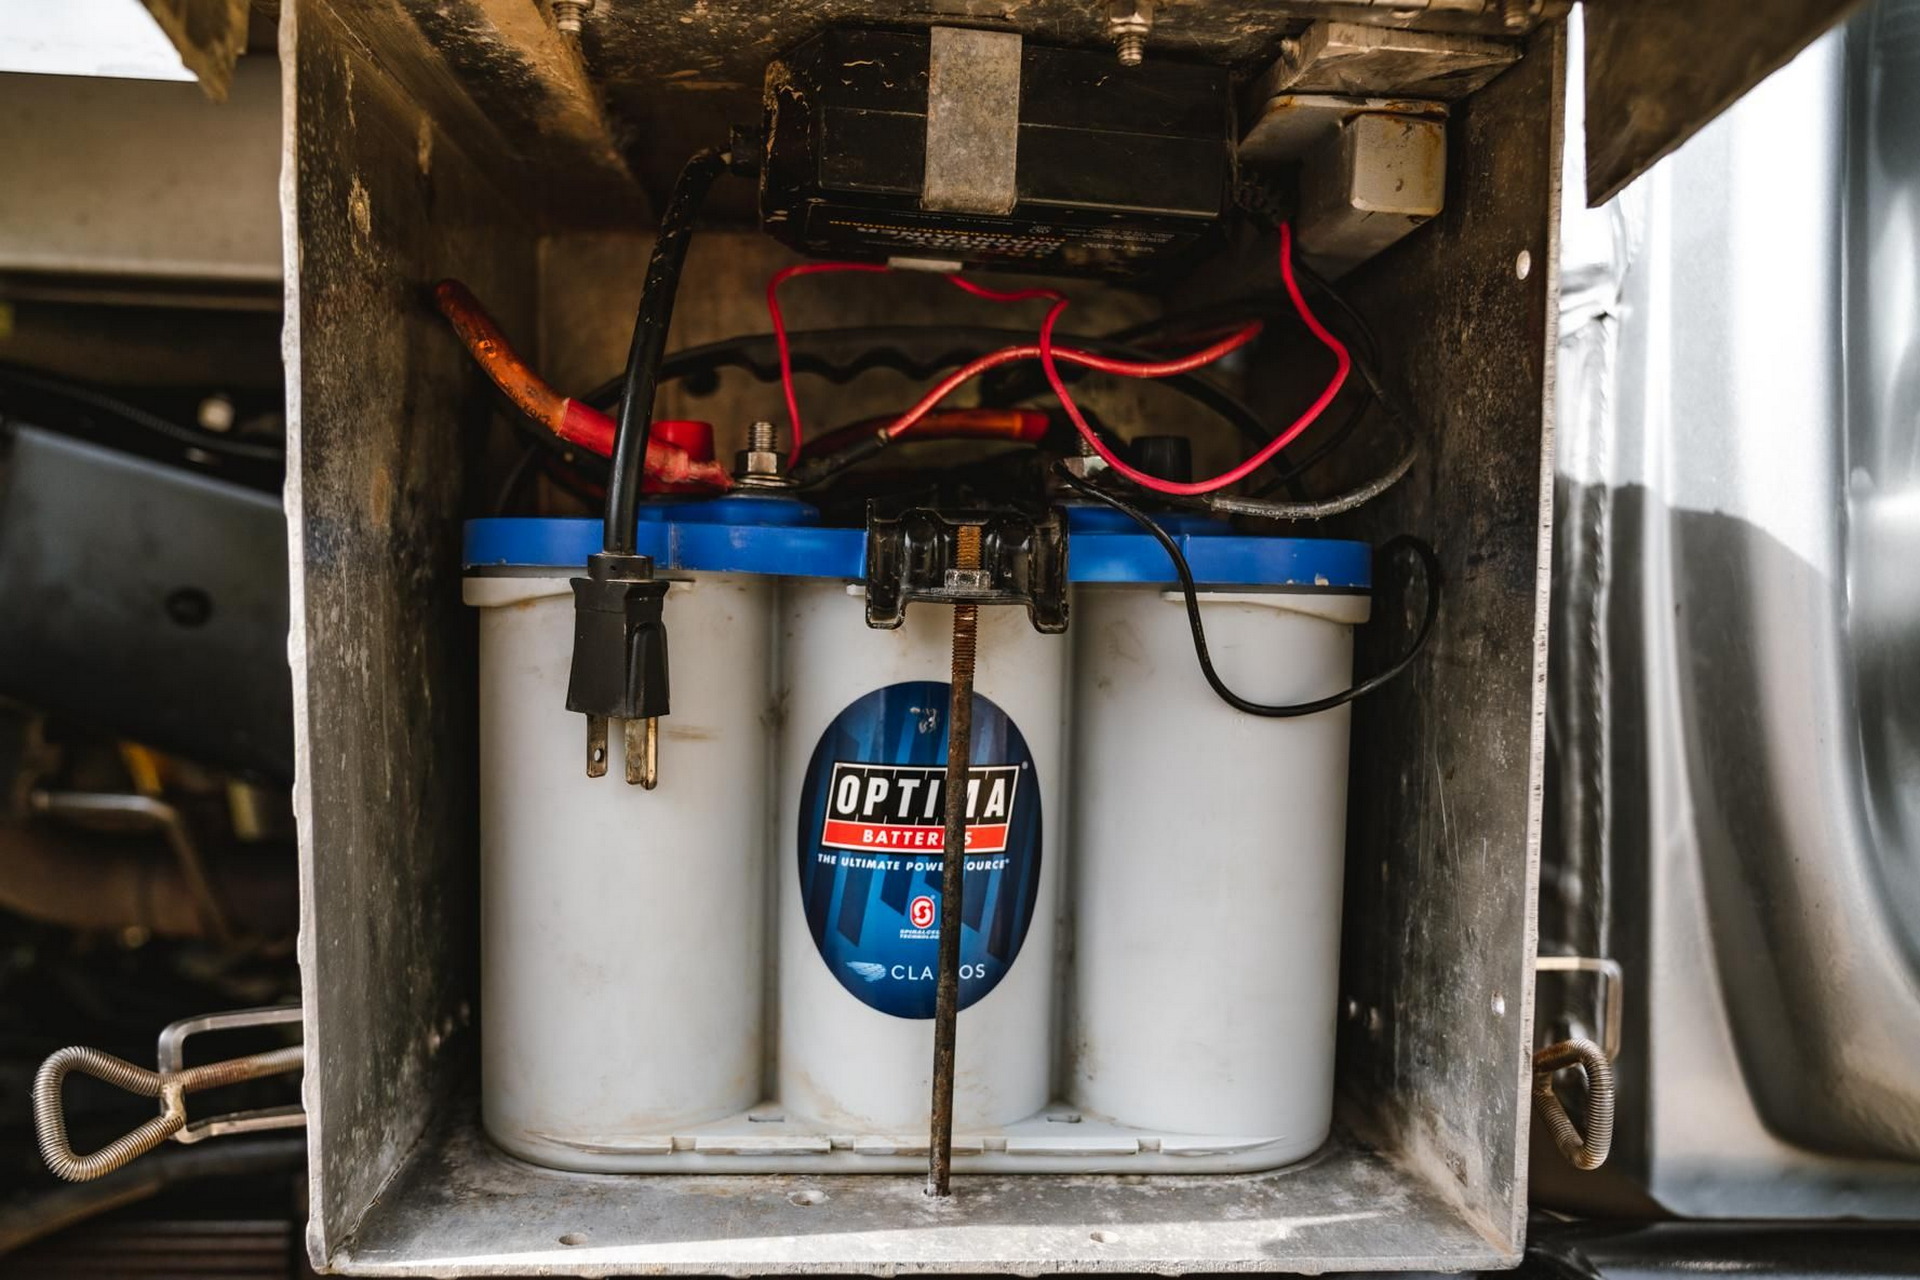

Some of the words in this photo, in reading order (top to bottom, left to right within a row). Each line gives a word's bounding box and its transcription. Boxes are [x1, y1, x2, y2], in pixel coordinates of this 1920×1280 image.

[817, 853, 837, 866] THE
[841, 856, 900, 871] ULTIMATE
[906, 861, 944, 872] POWE
[964, 859, 1006, 872] OURCE
[891, 963, 986, 981] CLAOS
